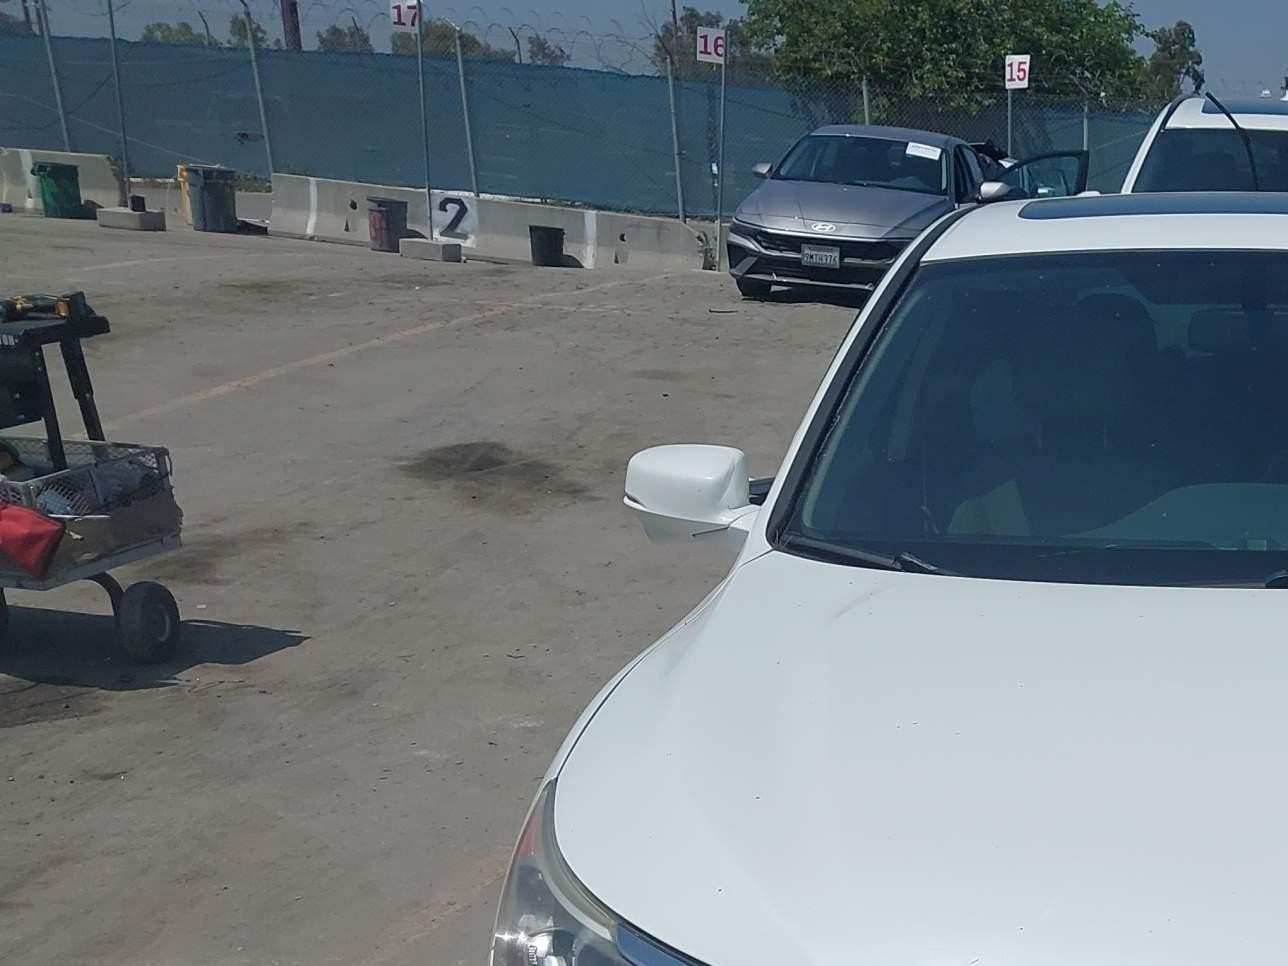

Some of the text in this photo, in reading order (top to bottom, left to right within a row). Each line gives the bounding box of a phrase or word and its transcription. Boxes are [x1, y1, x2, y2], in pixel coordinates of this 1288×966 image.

[392, 5, 417, 27] 17
[698, 34, 725, 57] 16
[1007, 61, 1027, 81] 15
[439, 197, 469, 240] 2
